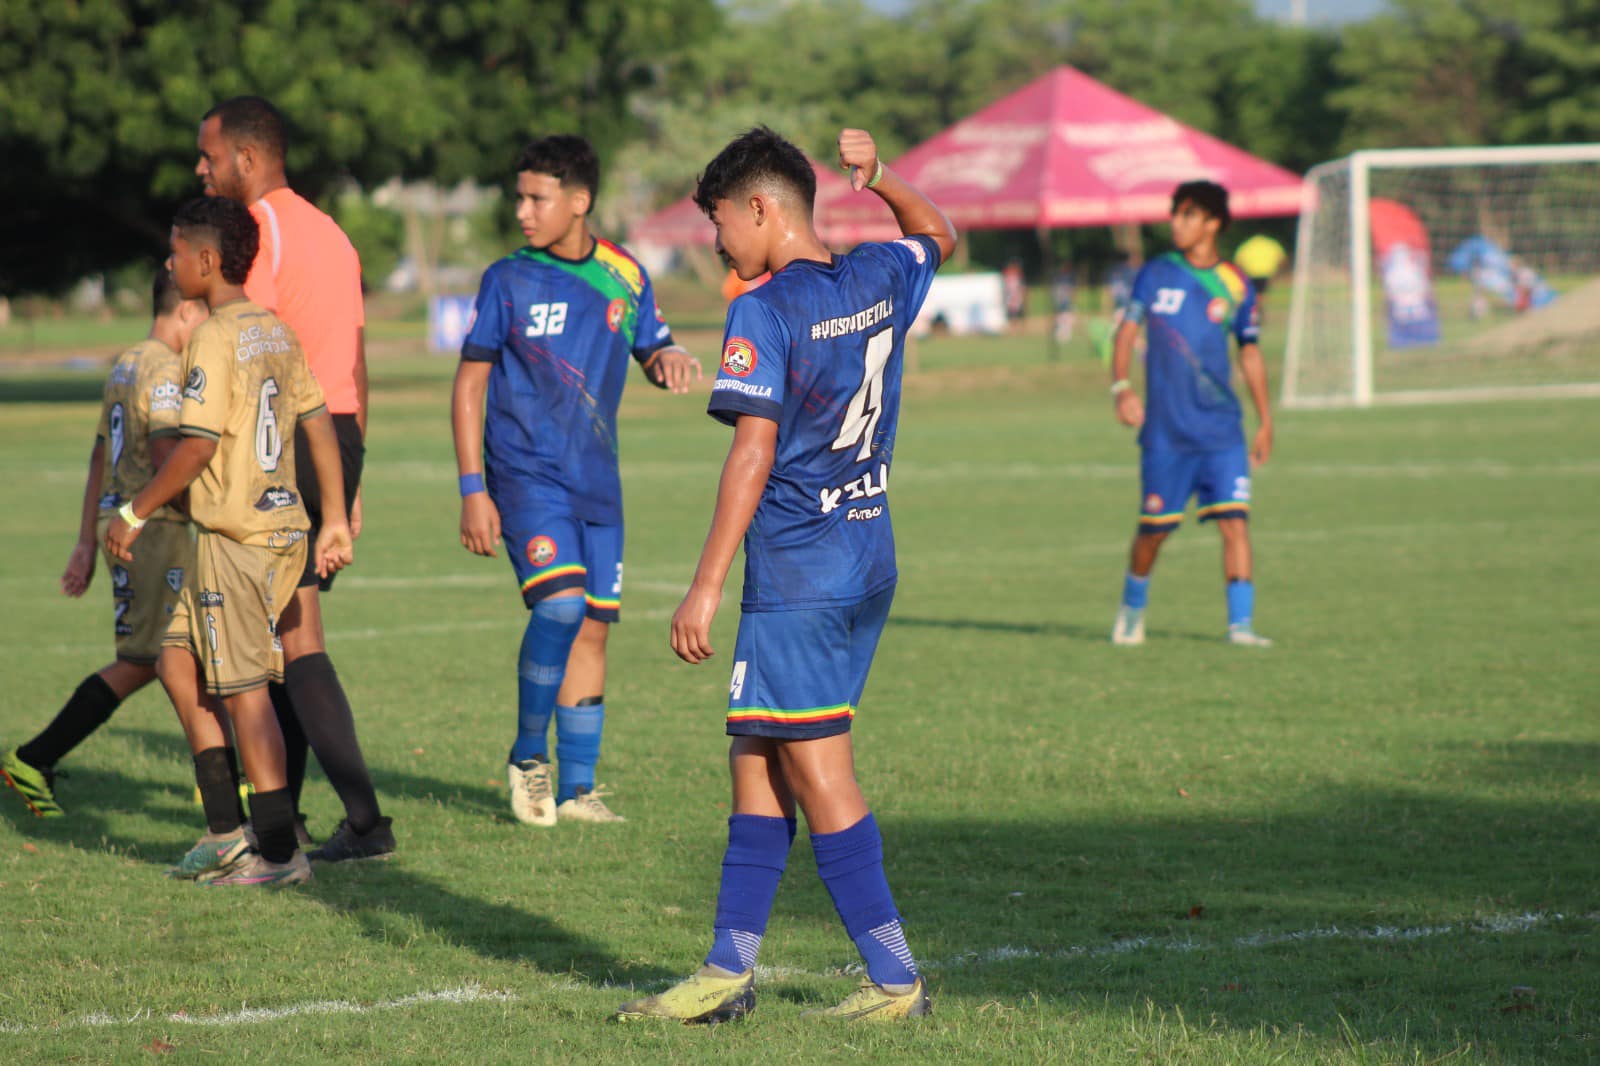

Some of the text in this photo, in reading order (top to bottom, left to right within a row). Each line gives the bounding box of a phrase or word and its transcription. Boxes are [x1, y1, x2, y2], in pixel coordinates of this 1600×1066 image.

[526, 302, 568, 337] 32
[256, 377, 282, 472] 6
[831, 326, 893, 462] 4
[730, 661, 747, 700] 4
